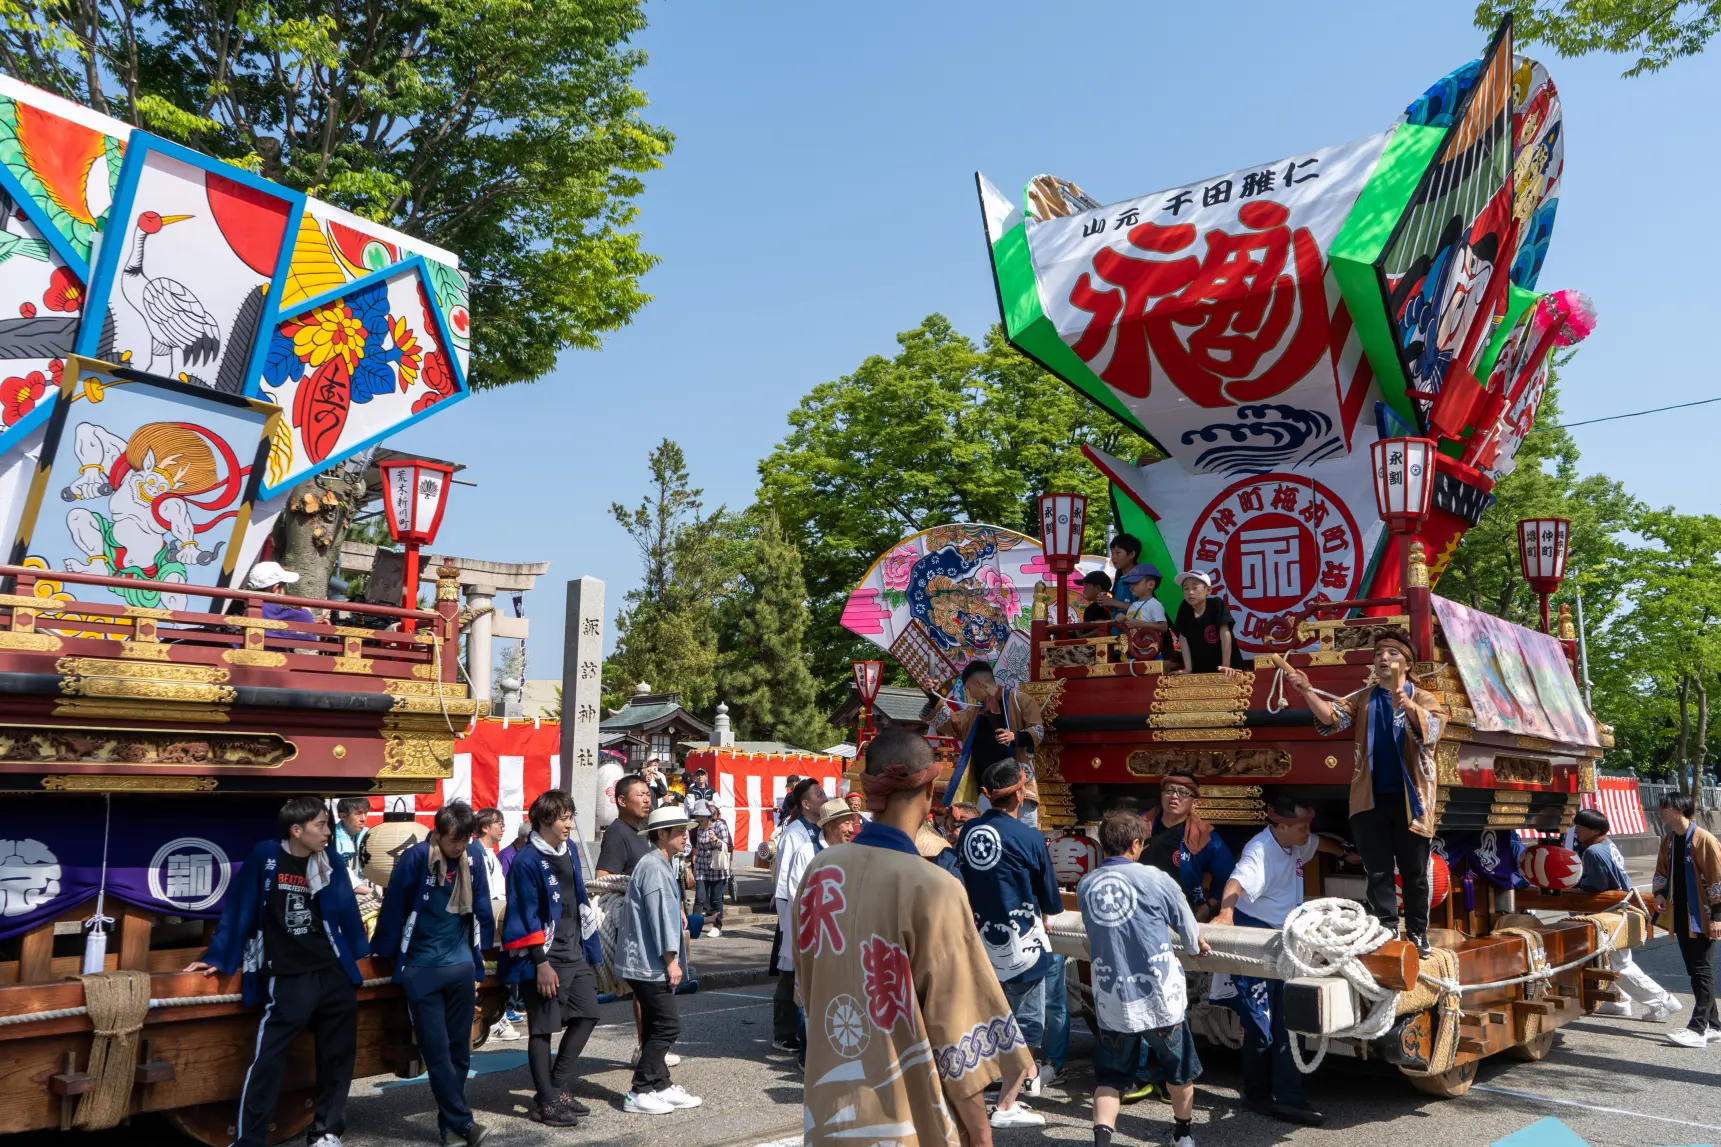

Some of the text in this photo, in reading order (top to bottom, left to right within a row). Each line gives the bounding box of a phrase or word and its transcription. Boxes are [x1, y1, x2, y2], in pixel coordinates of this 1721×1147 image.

[1389, 451, 1403, 485] 永割
[1541, 530, 1554, 558] 仲町
[577, 617, 600, 767] 諏訪神社
[278, 873, 308, 888] BEATRA
[292, 885, 313, 894] FESTIVA
[293, 926, 308, 936] 2015
